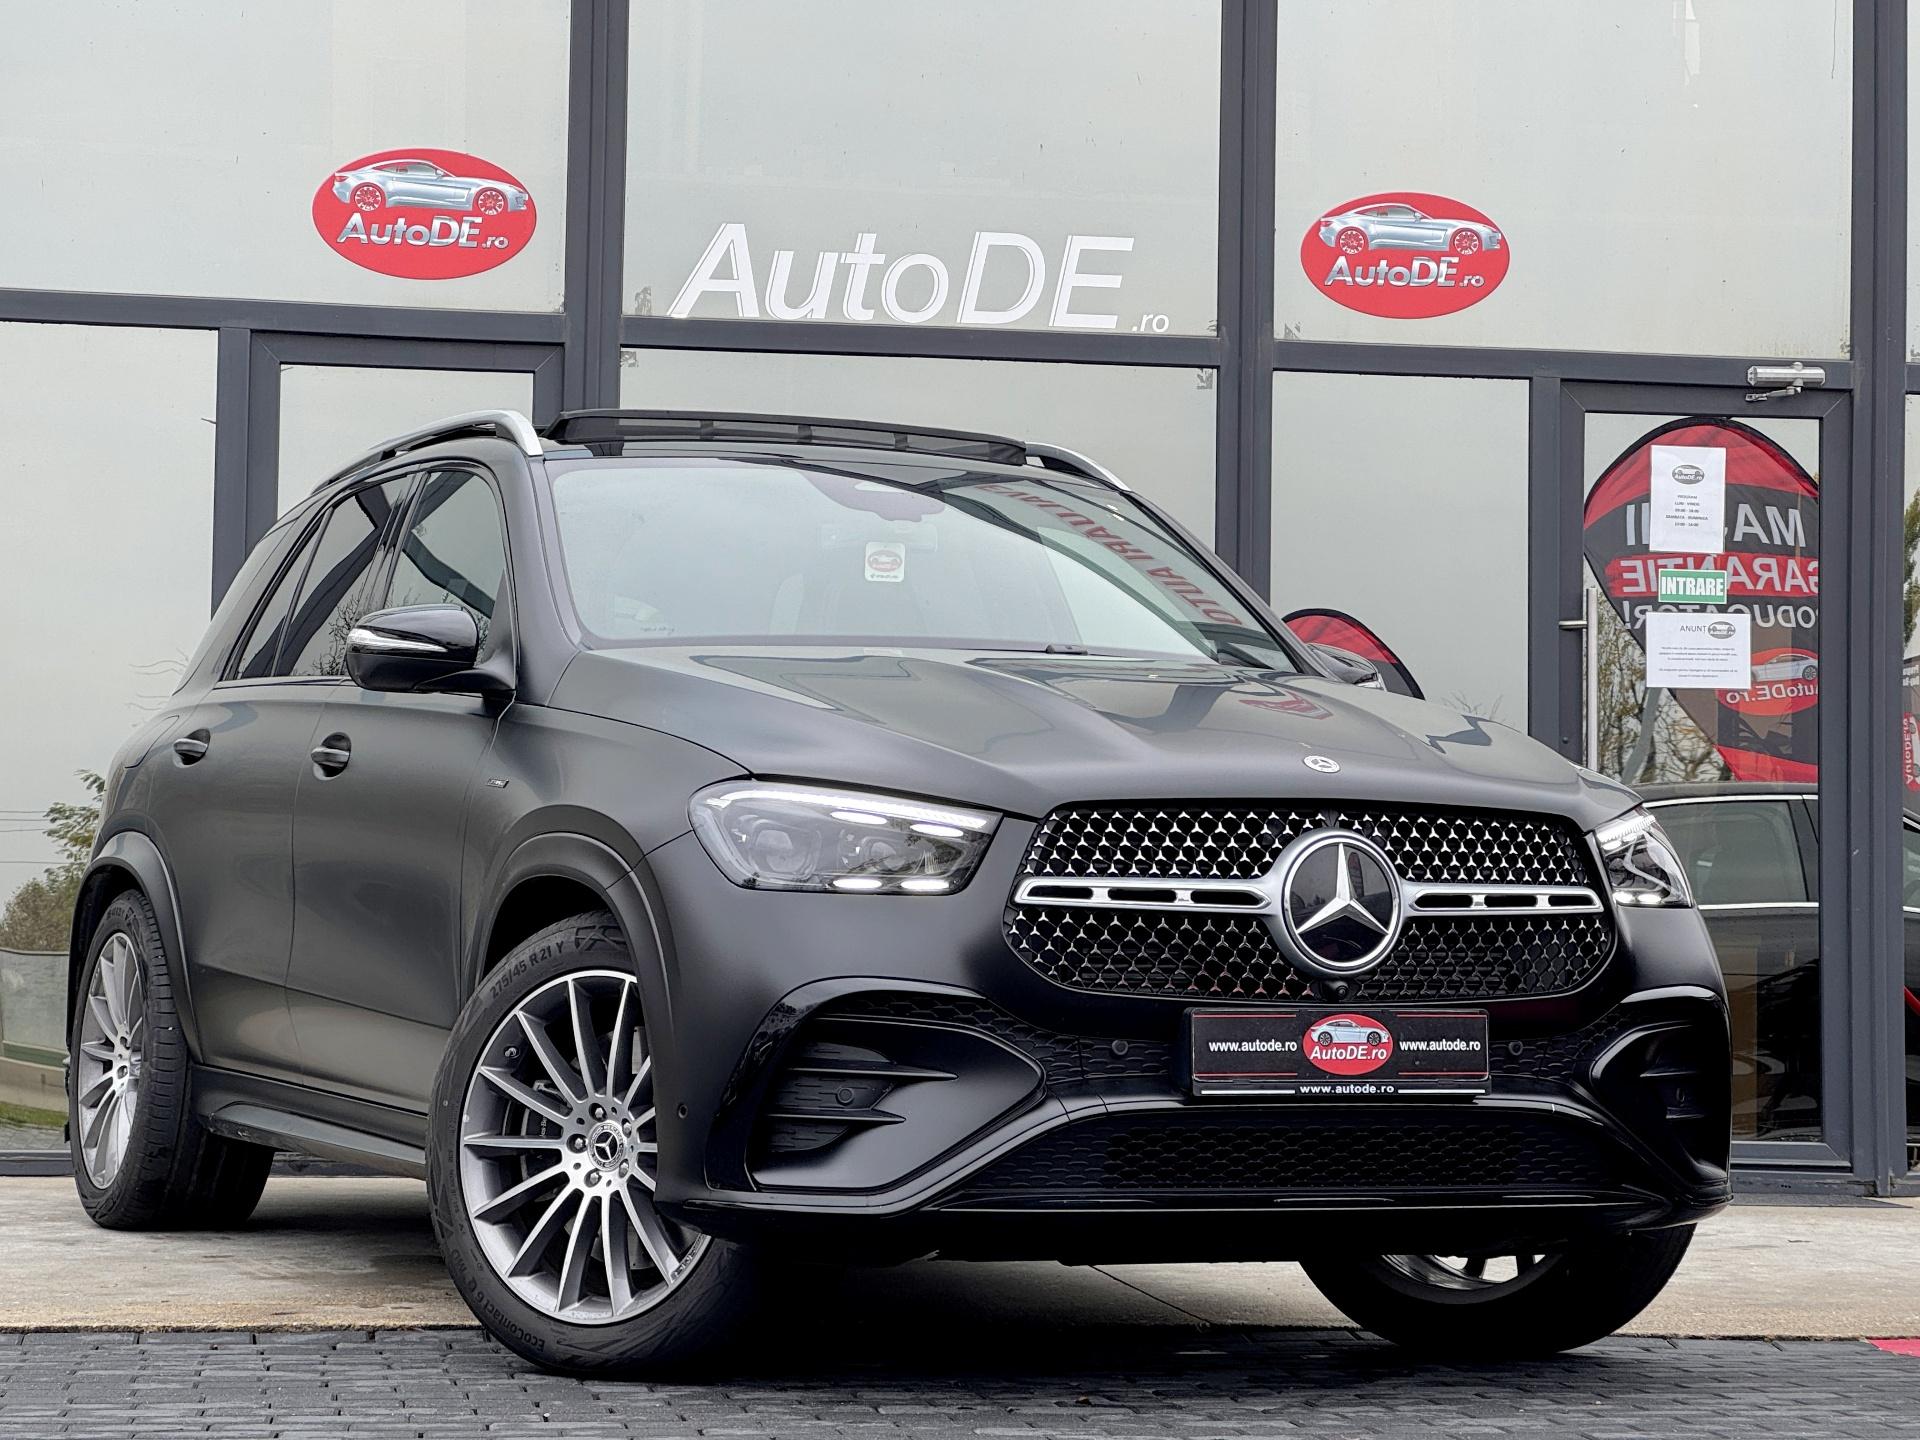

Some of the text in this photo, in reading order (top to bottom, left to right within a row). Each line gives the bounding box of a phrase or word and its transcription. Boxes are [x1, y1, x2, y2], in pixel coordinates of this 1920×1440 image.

[1661, 577, 1724, 596] INTRARE
[1209, 1039, 1297, 1052] www.autode.ro
[1399, 1039, 1481, 1051] www.autode.ro
[1310, 1045, 1387, 1060] AutoDE.ro
[1300, 1084, 1394, 1094] www.autode.ro
